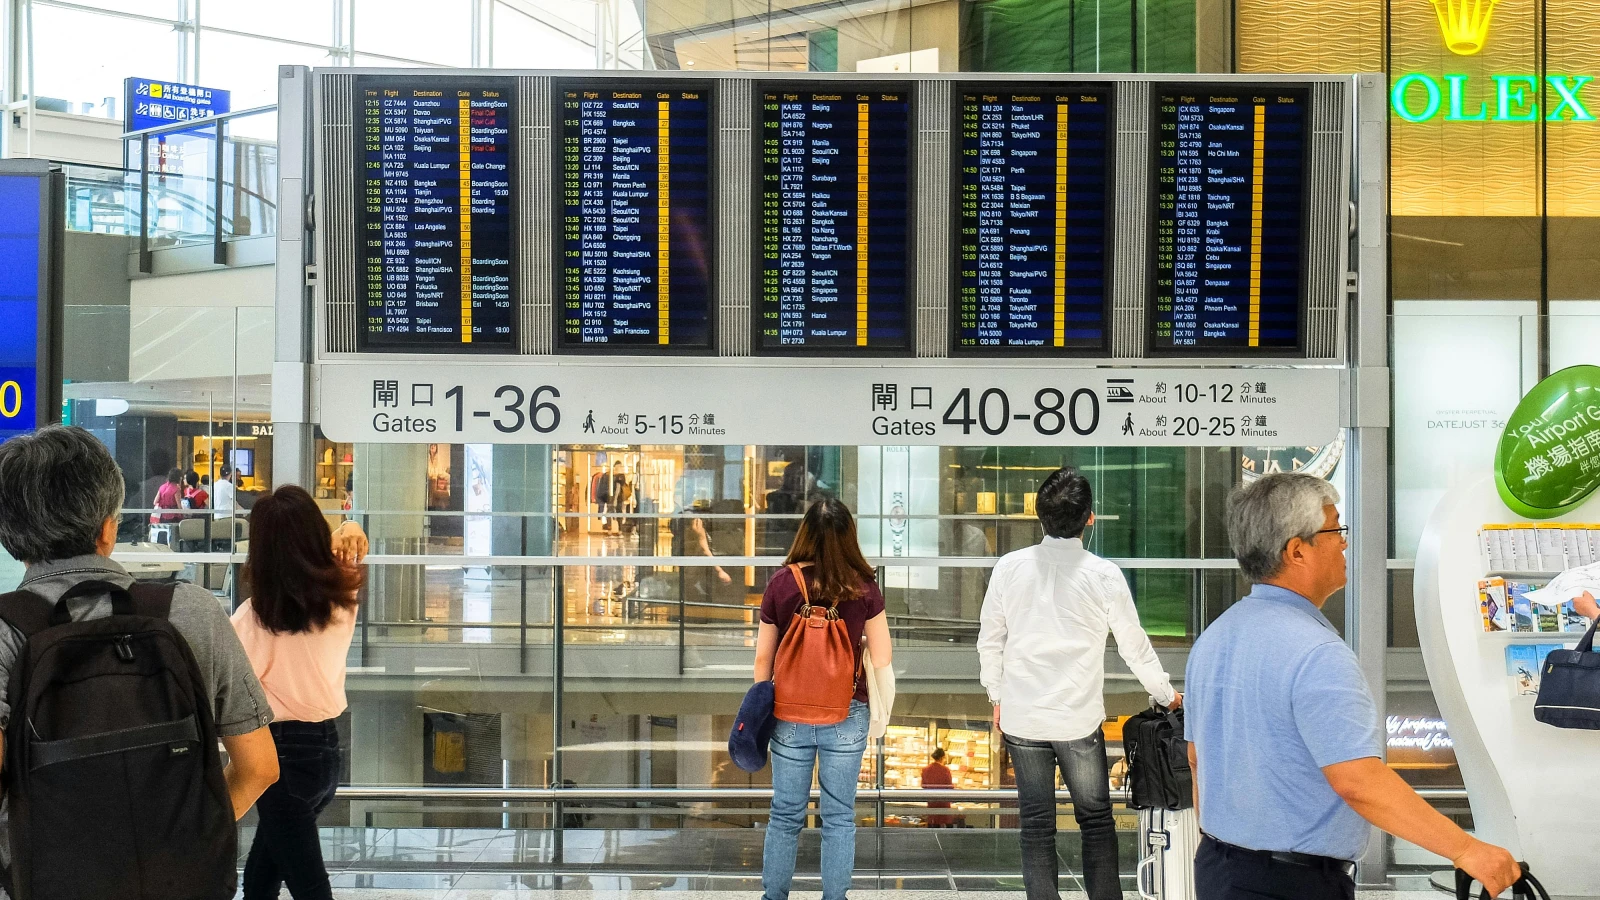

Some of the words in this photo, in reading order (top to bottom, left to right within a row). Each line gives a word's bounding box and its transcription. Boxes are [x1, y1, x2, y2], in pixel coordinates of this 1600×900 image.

[1391, 72, 1596, 122] OLEX
[373, 380, 434, 408] 閘口
[1139, 395, 1167, 404] About
[1174, 384, 1234, 403] 10-12
[1155, 381, 1167, 393] 約
[1241, 382, 1268, 394] 分鐘
[872, 384, 933, 411] 閘口
[1240, 395, 1276, 404] Minutes
[372, 412, 436, 432] Gates
[445, 385, 561, 433] 1-36
[872, 416, 936, 436] Gates
[942, 388, 1100, 436] 40-80
[601, 426, 629, 435] About
[634, 415, 683, 435] 5-15
[617, 412, 629, 425] 約
[688, 413, 715, 426] 分鐘
[1139, 428, 1167, 437] About
[1172, 416, 1236, 436] 20-25
[1155, 415, 1167, 427] 約
[1241, 415, 1268, 428] 分鐘
[1427, 420, 1487, 429] DATEJUST
[1491, 420, 1505, 428] 36
[1526, 412, 1588, 448] Airport
[1586, 405, 1600, 420] G
[689, 426, 725, 435] Minutes
[1241, 428, 1278, 437] Minutes
[1398, 717, 1447, 734] prepare
[1387, 733, 1432, 747] natural
[1422, 733, 1453, 750] foo
